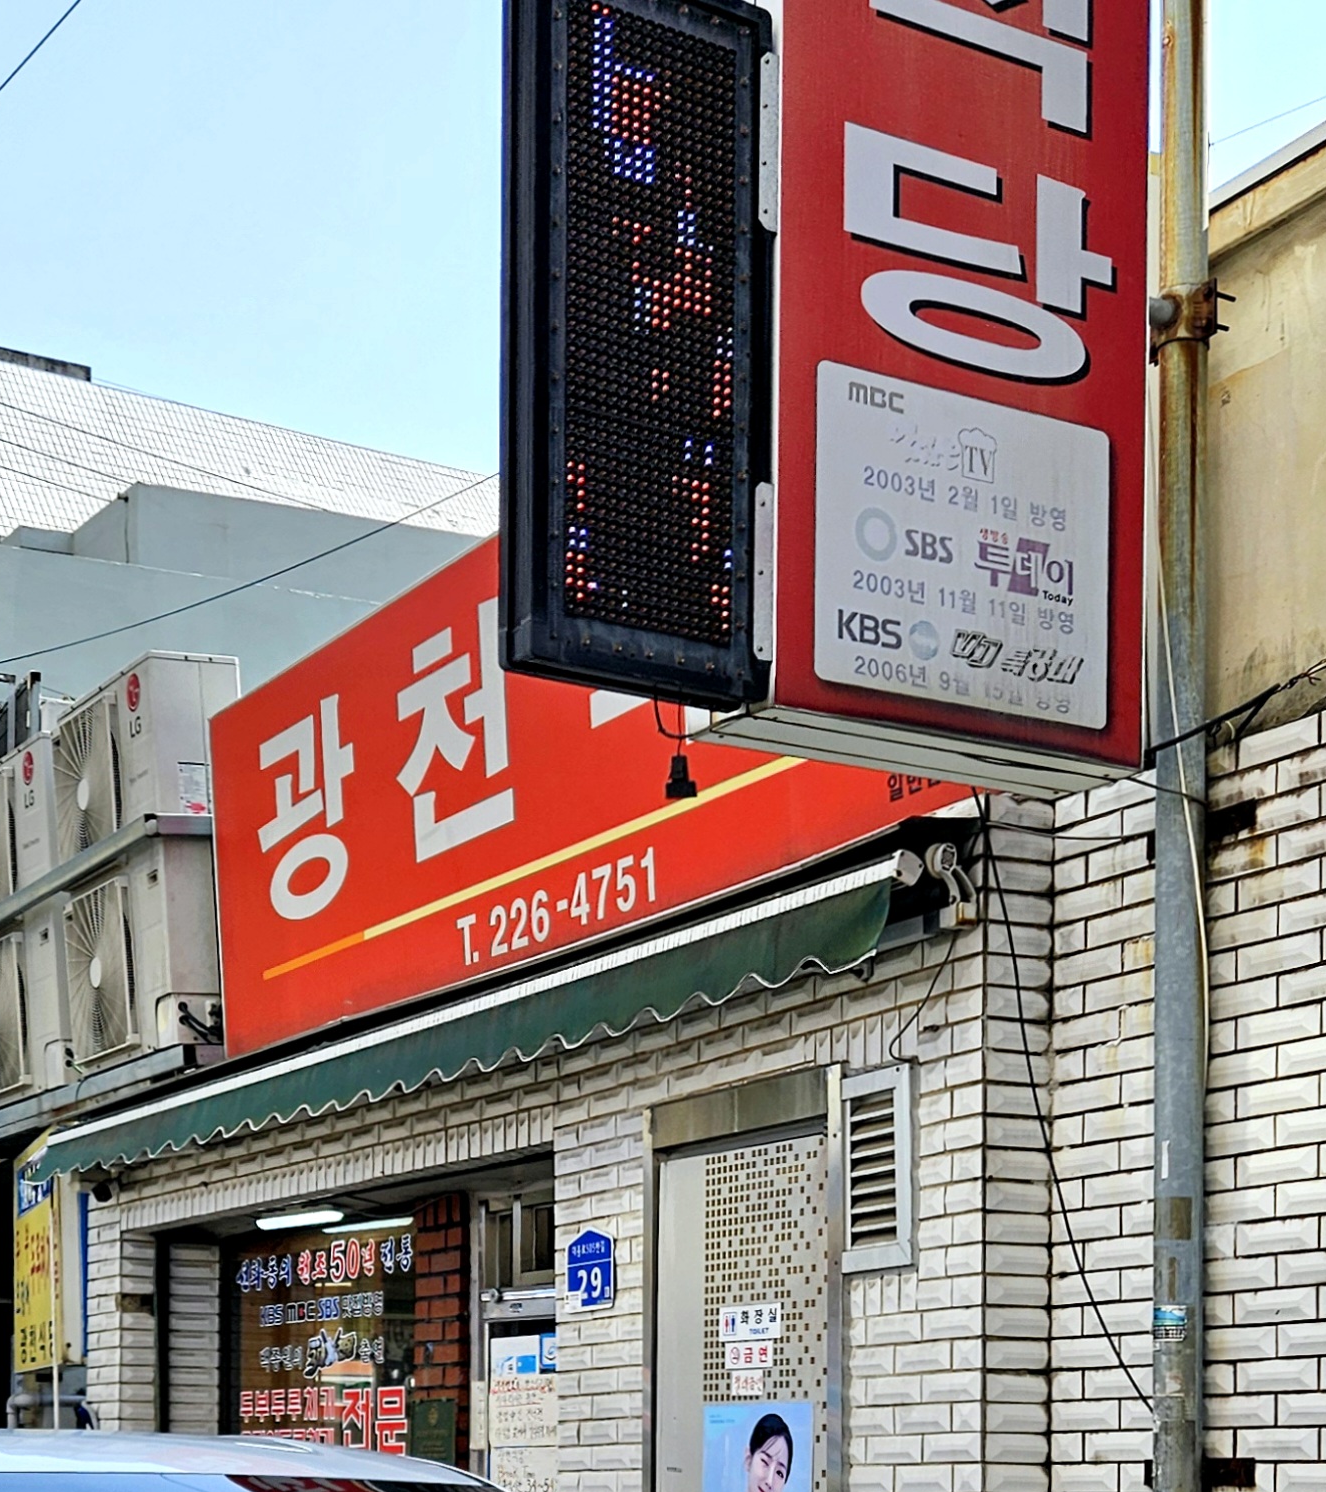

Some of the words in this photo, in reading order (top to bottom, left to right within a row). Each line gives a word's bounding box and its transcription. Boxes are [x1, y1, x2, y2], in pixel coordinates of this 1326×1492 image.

[863, 465, 936, 502] 2003년
[948, 485, 978, 513] 2월
[991, 494, 1018, 521] 1일
[1029, 500, 1067, 532] 방영
[904, 528, 954, 564] SBS
[974, 536, 1074, 597] 투데이
[852, 569, 926, 605] 2003년
[938, 587, 977, 615] 11월
[989, 598, 1026, 626] 11일
[1037, 606, 1074, 635] 방영
[1041, 589, 1074, 607] Today
[836, 608, 903, 650] KBS
[853, 655, 928, 689] 2006년
[128, 715, 142, 739] LG
[23, 789, 35, 810] LG
[886, 772, 941, 803] 일반
[489, 845, 657, 959] 226-4751
[577, 1266, 602, 1300] 29
[285, 1300, 317, 1324] MBC
[316, 1296, 341, 1322] SBS
[740, 1307, 778, 1325] 화장실
[749, 1327, 770, 1336] TOILET
[744, 1345, 769, 1364] 금연
[341, 1385, 409, 1458] 전문
